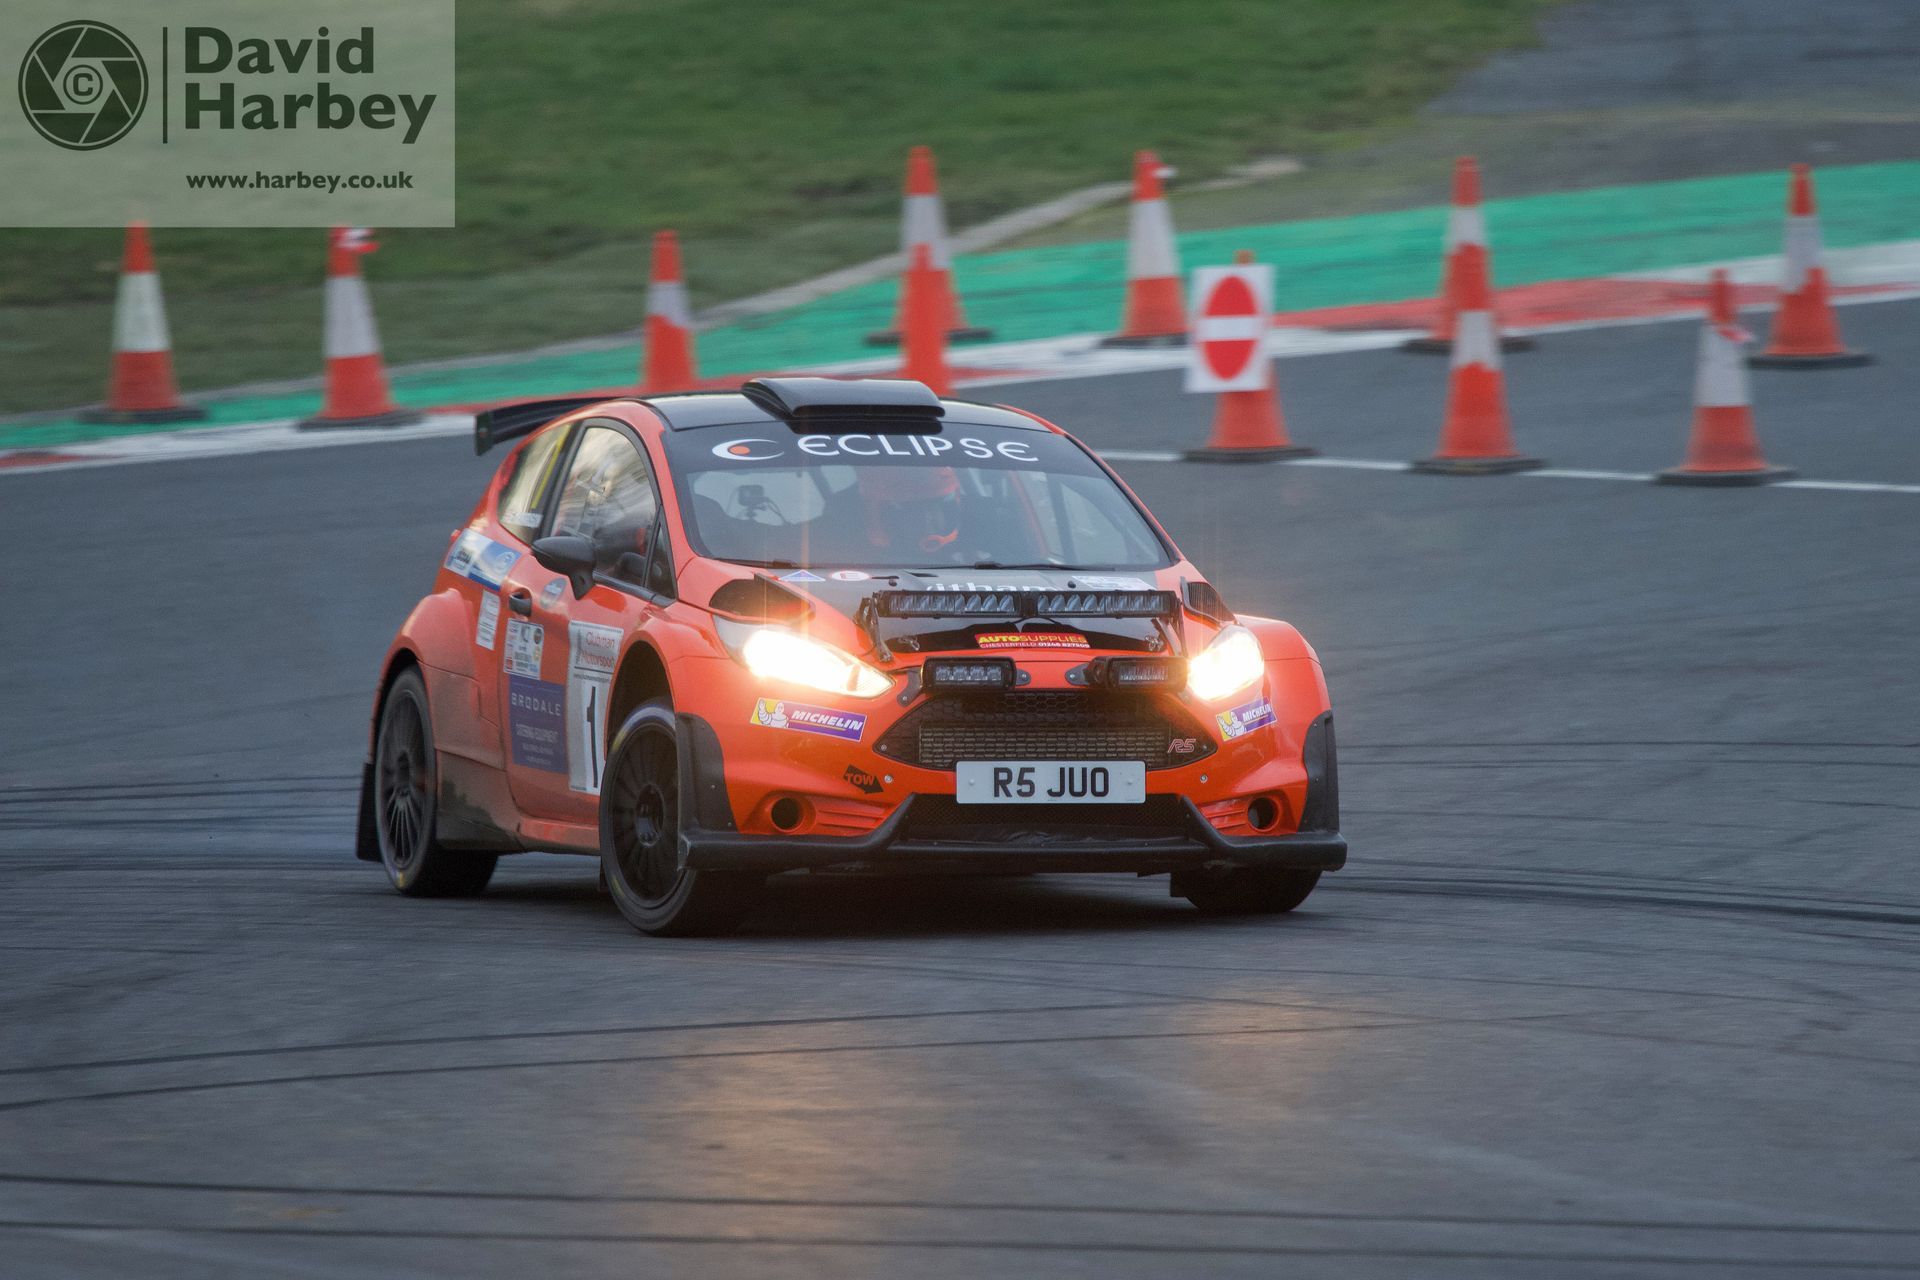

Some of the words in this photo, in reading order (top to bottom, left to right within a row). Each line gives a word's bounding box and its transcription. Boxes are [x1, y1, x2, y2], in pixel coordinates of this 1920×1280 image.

[797, 434, 1039, 462] ECLIPSE
[511, 692, 561, 717] BRODALE
[1242, 703, 1272, 722] MICHELIN
[791, 710, 864, 731] MICHELIN
[586, 685, 599, 789] 1
[845, 772, 875, 786] TOW
[993, 766, 1036, 798] R5
[1046, 766, 1110, 798] JUO
